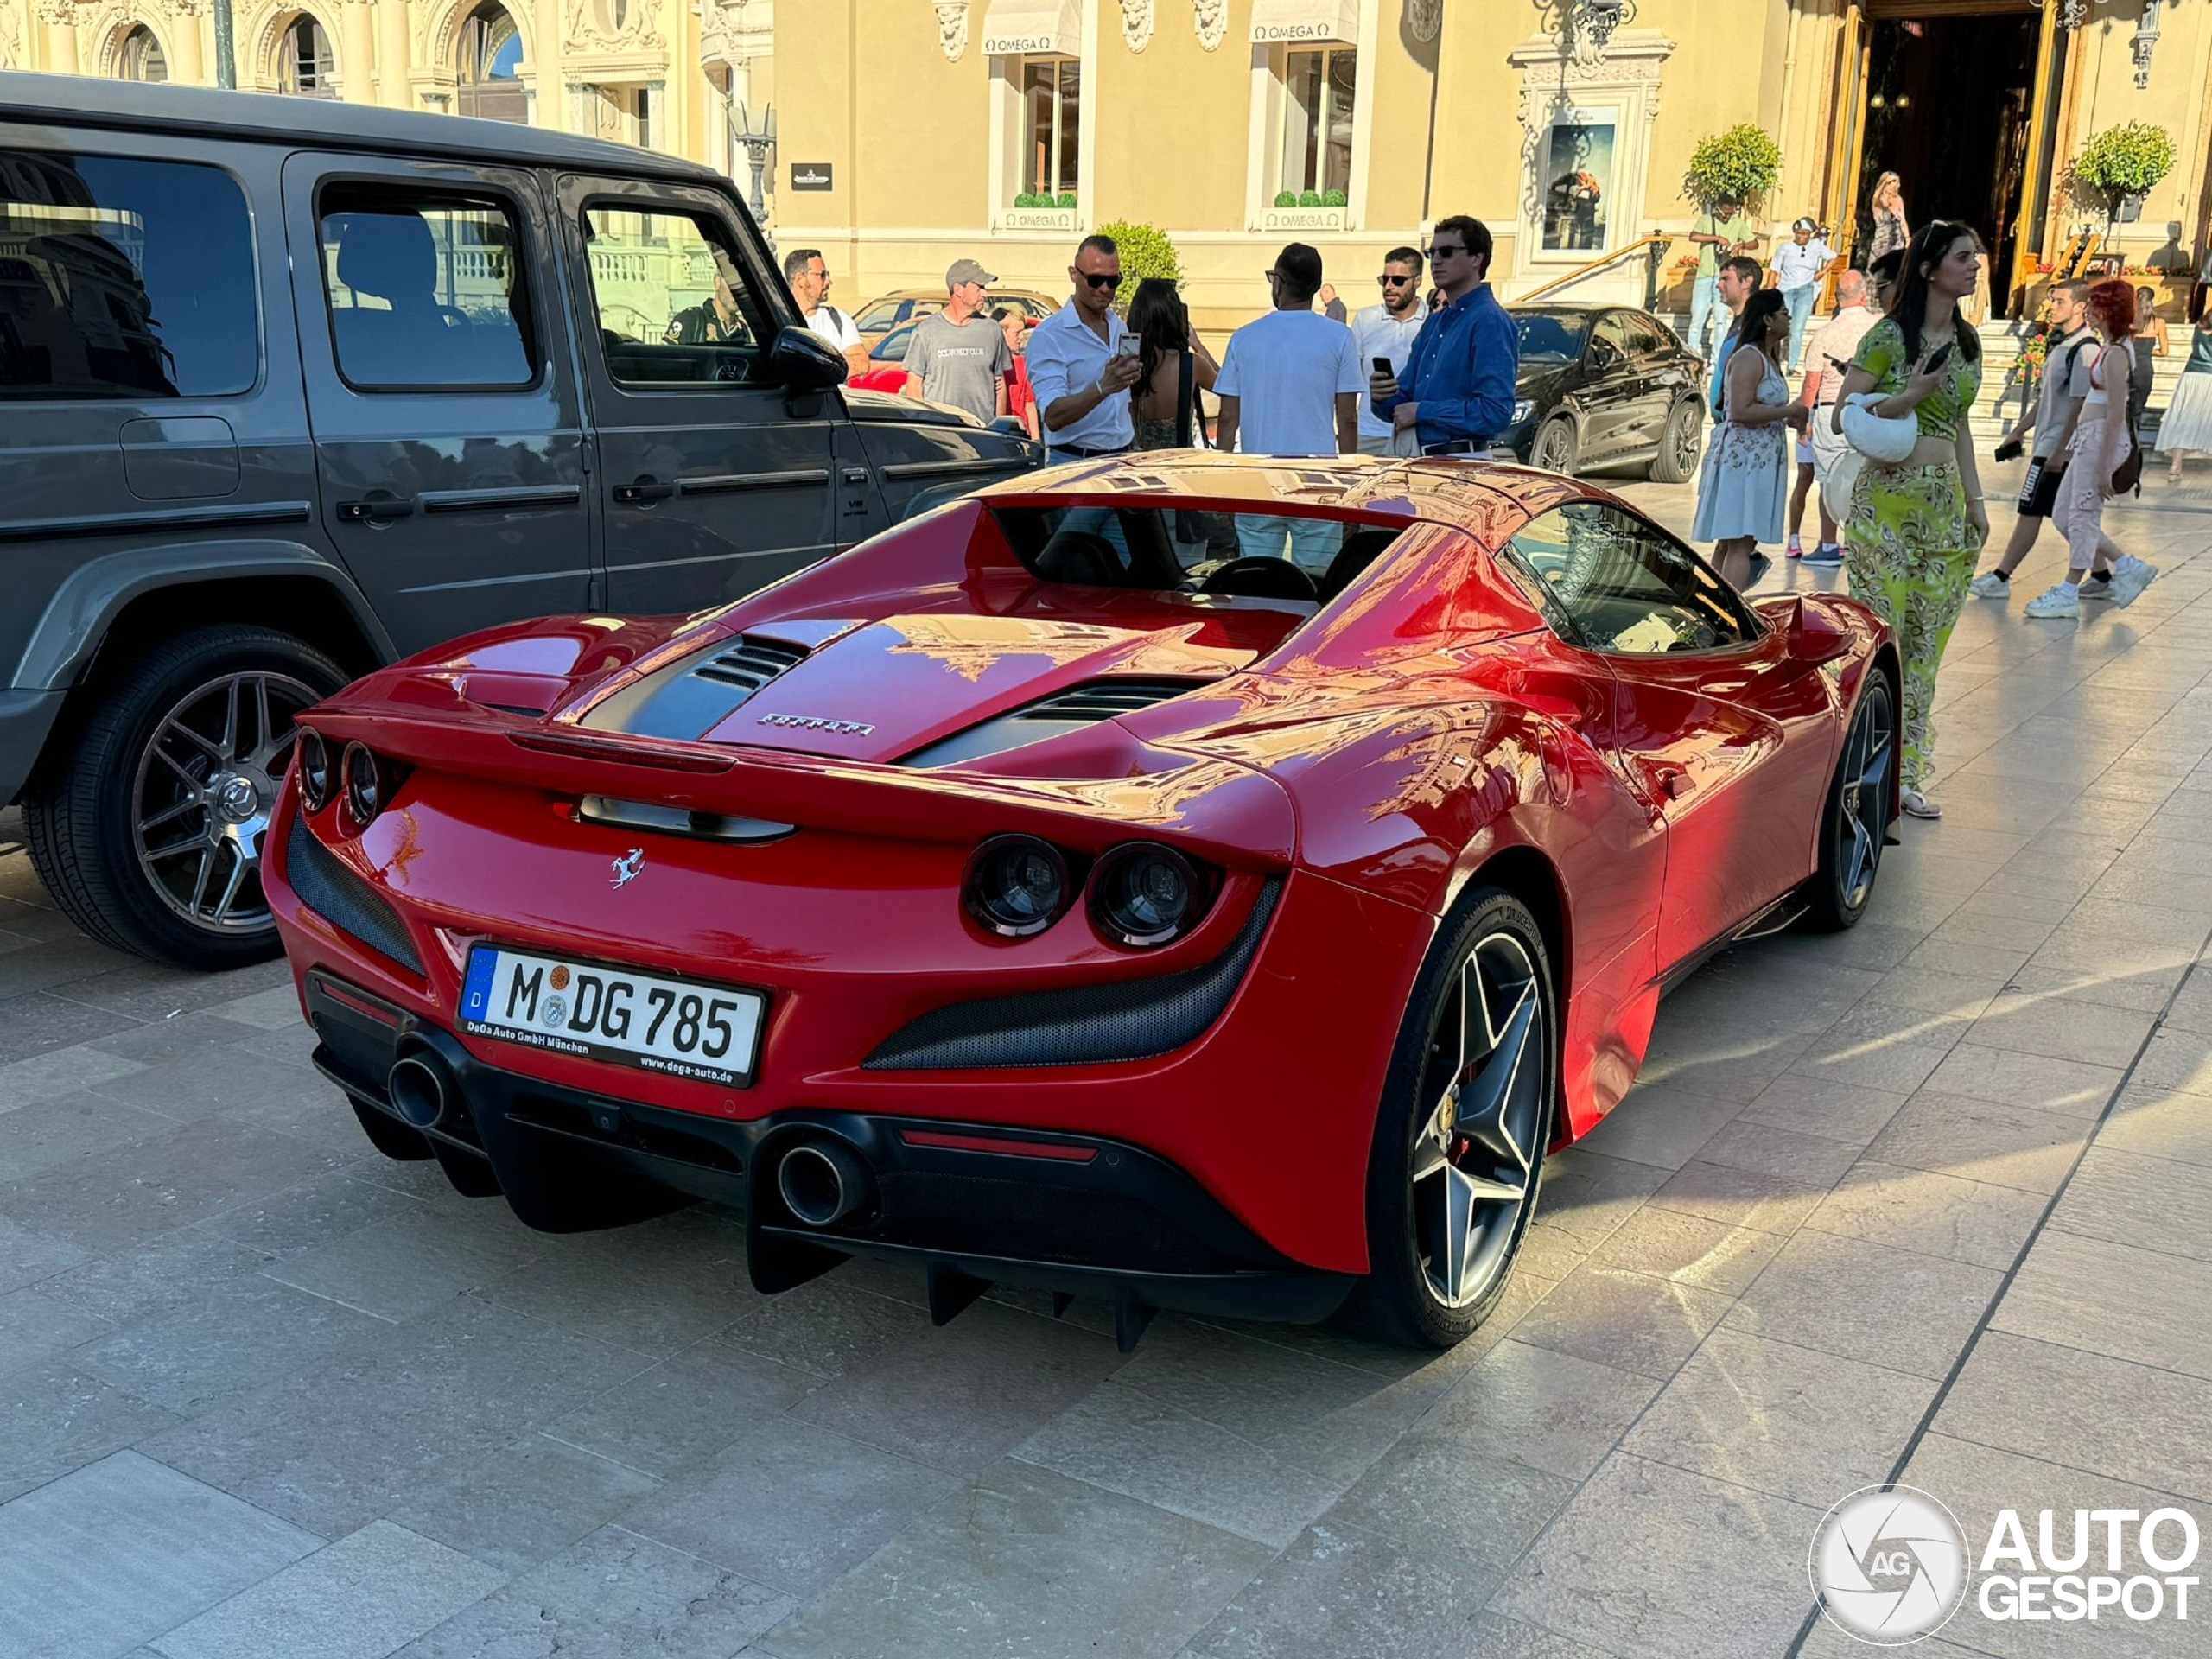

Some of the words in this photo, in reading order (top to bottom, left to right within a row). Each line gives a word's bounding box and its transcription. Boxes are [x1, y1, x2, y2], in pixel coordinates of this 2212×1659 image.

[1269, 25, 1313, 39] OMEGA
[997, 39, 1037, 51] OMEGA
[1020, 215, 1056, 226] OMEGA
[1281, 215, 1324, 226] OMEGA
[757, 713, 876, 737] Ferrari
[470, 992, 481, 1008] D
[505, 963, 543, 1022] M
[567, 974, 635, 1040] DG
[645, 988, 738, 1058] 785
[467, 1021, 493, 1034] DeGa
[493, 1027, 516, 1040] Auto
[517, 1032, 545, 1046] GmbH
[546, 1037, 589, 1055] München
[640, 1057, 734, 1083] www.dega-auto.de
